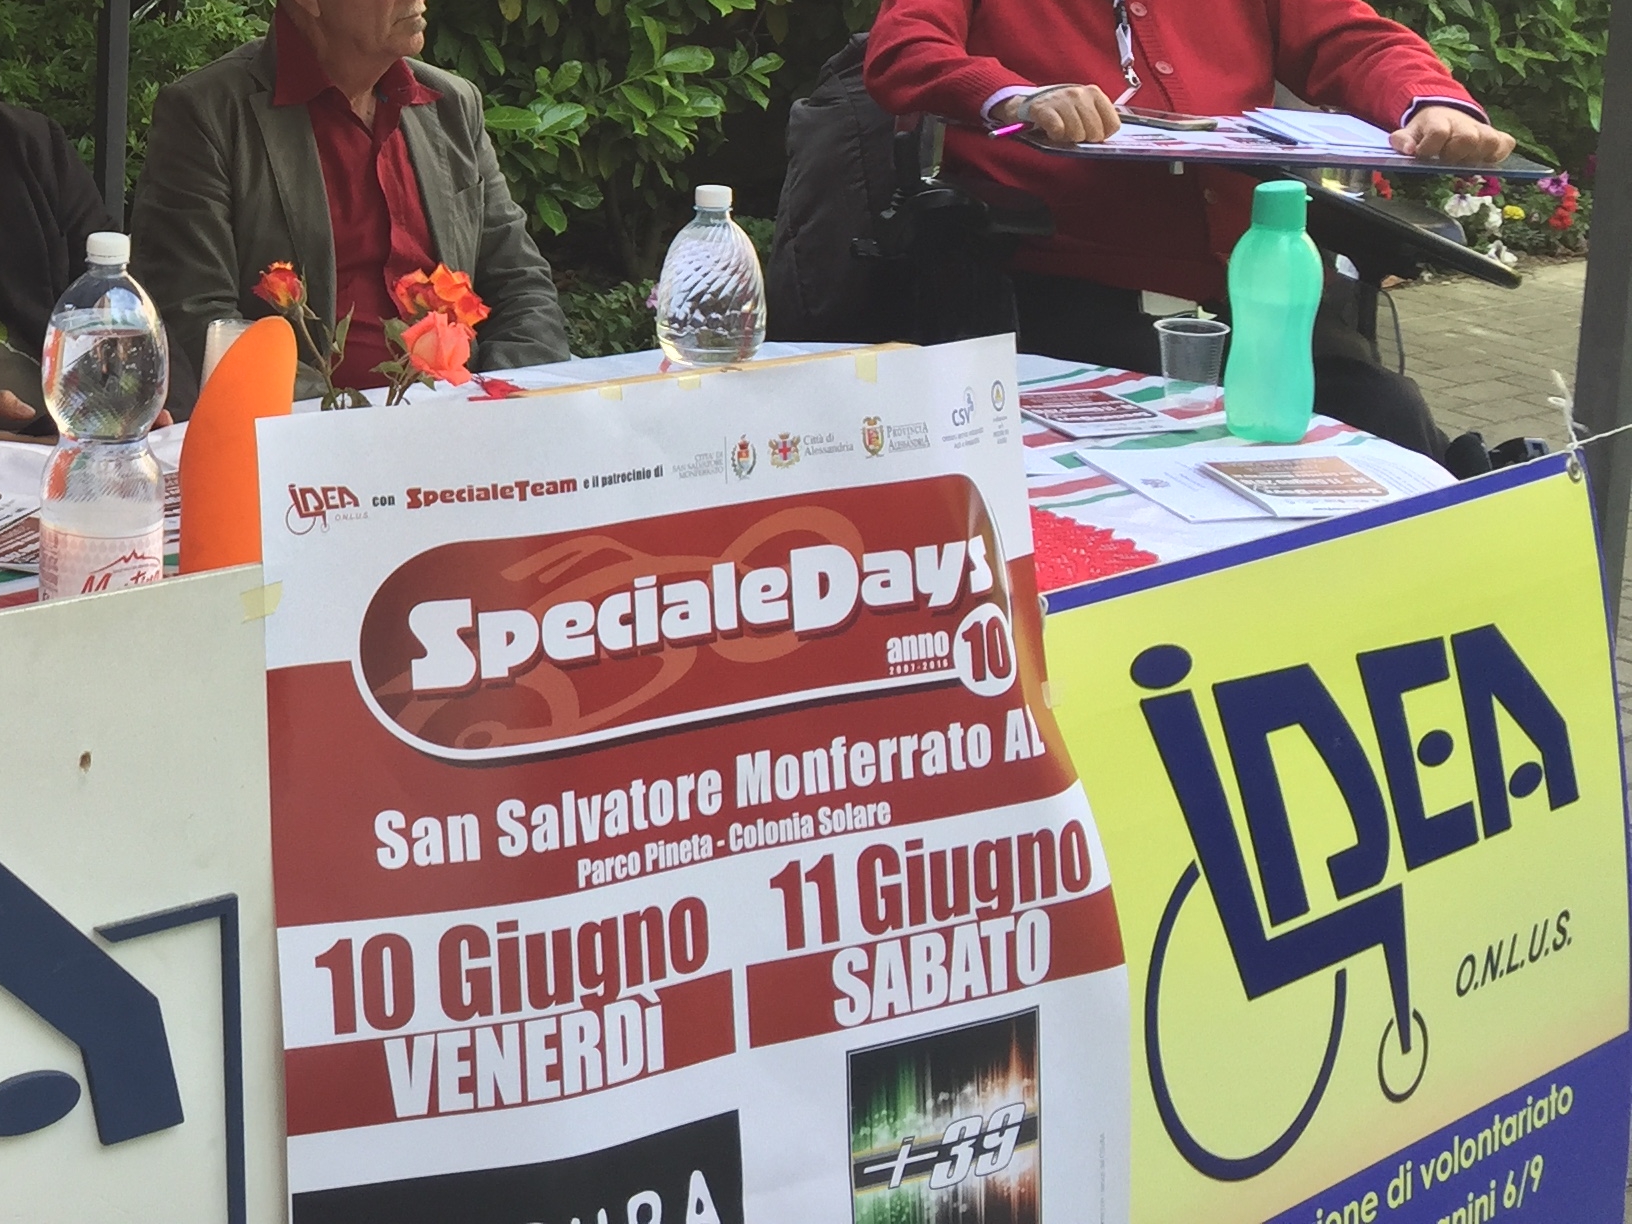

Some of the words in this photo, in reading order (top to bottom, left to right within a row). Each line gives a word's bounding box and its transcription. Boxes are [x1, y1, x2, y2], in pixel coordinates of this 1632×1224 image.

[803, 433, 824, 446] Città
[826, 432, 835, 443] di
[804, 441, 855, 457] Alessandria
[886, 422, 929, 439] PROVINCIA
[888, 434, 931, 451] ALESSANDRIA
[951, 406, 971, 427] CSV
[371, 493, 396, 508] con
[406, 476, 578, 509] SpecialeTeam
[583, 478, 590, 490] e
[592, 475, 600, 490] il
[601, 468, 653, 488] patrocinio
[654, 464, 664, 478] di
[407, 534, 994, 692] SpecialeDays
[886, 630, 950, 665] anno
[961, 616, 1013, 681] 10
[888, 658, 950, 676] 2007-2016
[373, 807, 481, 870] San
[497, 765, 723, 859] Salvatore
[734, 725, 993, 809] Monferrato
[1004, 706, 1046, 763] AL
[577, 851, 641, 888] Parco
[644, 833, 714, 876] Pineta
[728, 810, 815, 855] Colonia
[817, 796, 893, 841] Solare
[769, 853, 843, 952] 11
[855, 817, 1094, 938] Giugno
[314, 932, 415, 1037] 10
[436, 894, 711, 1028] Giugno
[832, 908, 1052, 1028] SABATO
[1455, 910, 1574, 999] O.N.L.U.S.
[863, 1101, 1027, 1191] +39
[1386, 1161, 1413, 1210] di
[1419, 1083, 1575, 1191] volontariato
[1502, 1153, 1545, 1210] 6/9
